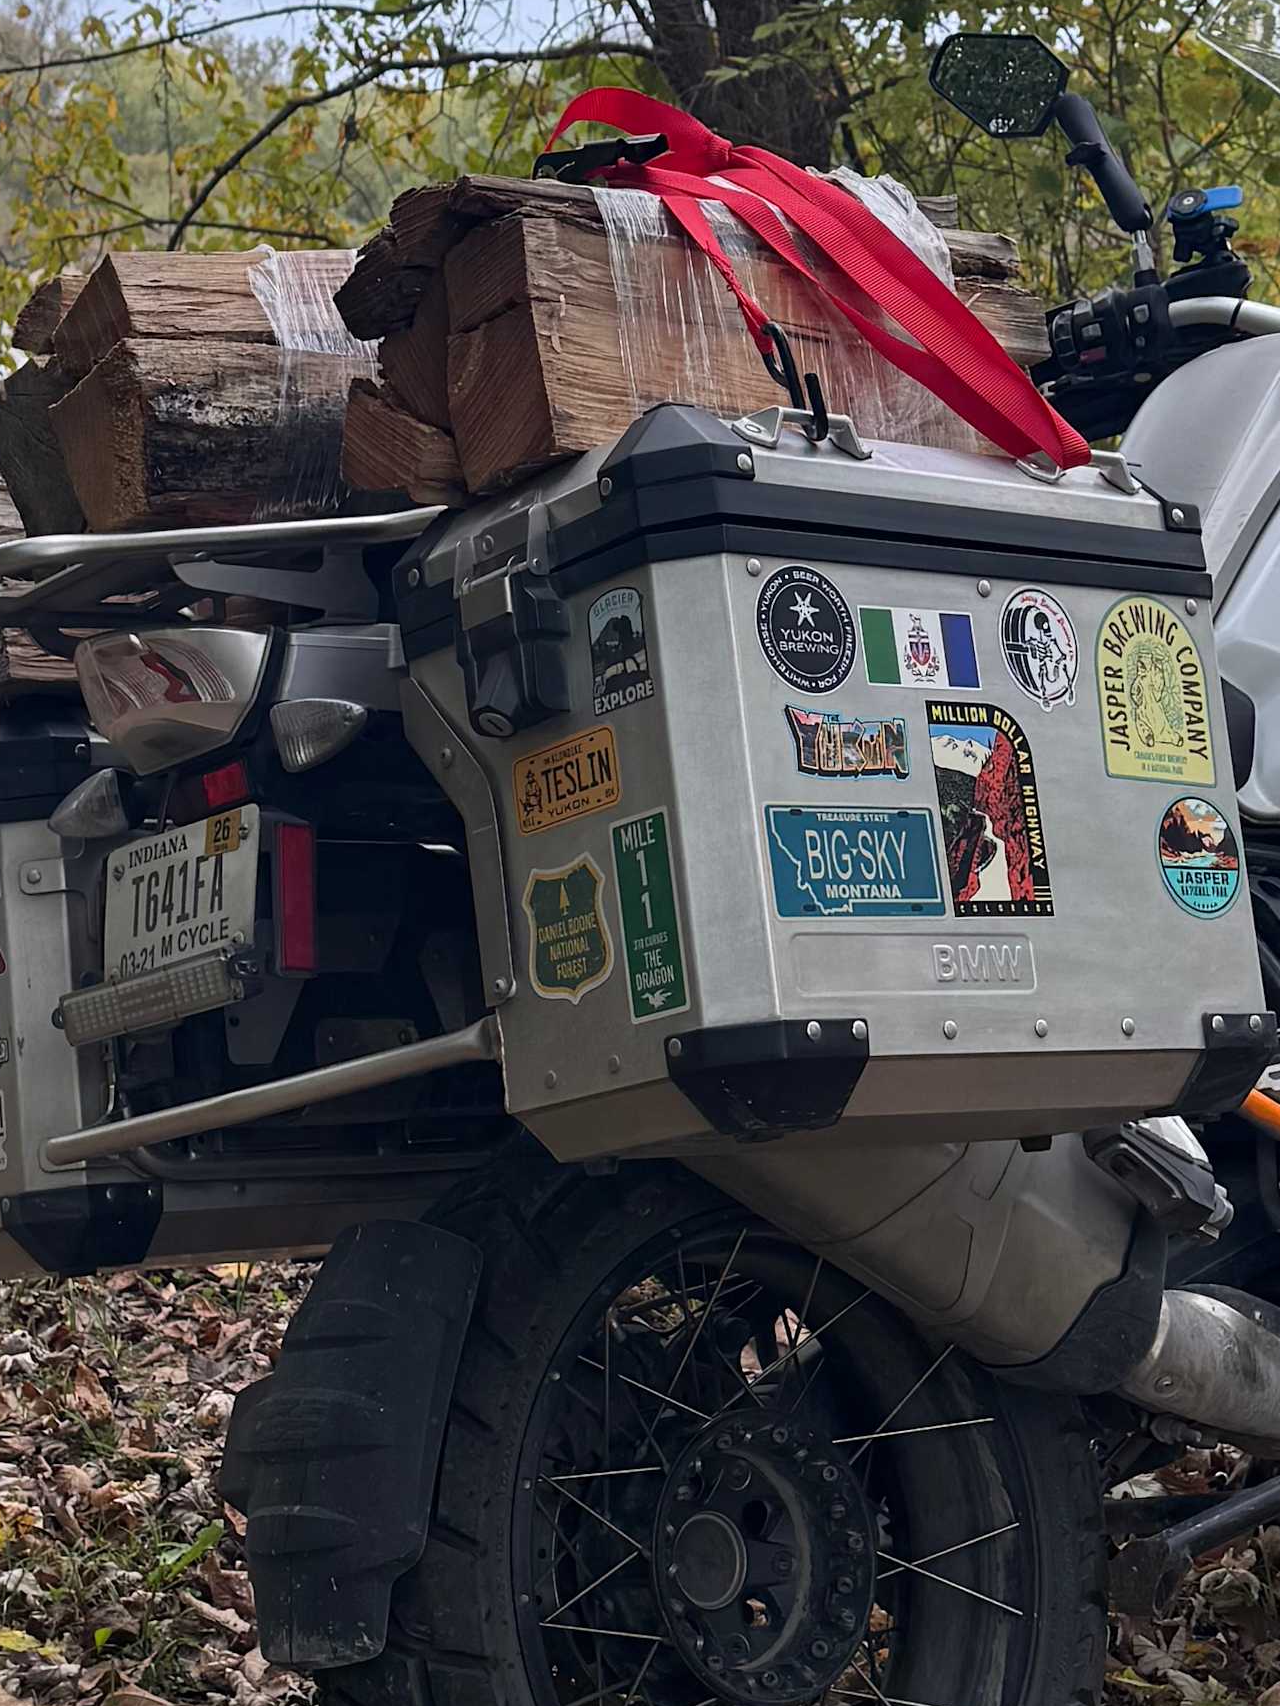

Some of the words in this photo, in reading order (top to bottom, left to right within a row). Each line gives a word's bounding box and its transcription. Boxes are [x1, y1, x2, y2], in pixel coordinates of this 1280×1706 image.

[761, 576, 783, 612] YUKON
[792, 570, 820, 585] BEER
[593, 592, 634, 618] GLACIER
[821, 579, 851, 624] WORTH
[779, 640, 840, 655] BREWING
[780, 627, 835, 644] YUKON
[1103, 603, 1179, 659] BREWING
[760, 621, 811, 689] WHITEHORSE
[593, 679, 654, 715] EXPLORE
[817, 673, 839, 689] FOR
[1103, 665, 1131, 752] JASPER
[1175, 645, 1209, 761] COMPANY
[784, 704, 911, 779] YUKON
[541, 746, 613, 804] TESLIN
[931, 704, 989, 724] MILLION
[992, 709, 1032, 775] DOLLAR
[1021, 784, 1046, 870] HIGHWAY
[547, 796, 590, 818] YUKON
[816, 812, 862, 822] TREASURE
[863, 813, 890, 823] STATE
[213, 817, 231, 843] 26
[620, 818, 656, 853] MILE
[128, 834, 188, 869] INDIANA
[636, 849, 649, 886] 1
[805, 829, 853, 881] BIG
[857, 829, 907, 880] SKY
[131, 851, 224, 938] T641FA
[825, 884, 902, 899] MONTANA
[1177, 870, 1229, 886] JASPER
[641, 891, 653, 929] 1
[960, 904, 1052, 914] COLORADO
[161, 934, 173, 958] M
[177, 917, 230, 953] CYCLE
[538, 920, 568, 944] DANIEL
[569, 911, 597, 937] BOONE
[549, 934, 591, 961] NATIONAL
[643, 948, 663, 969] THE
[932, 943, 1022, 983] BMW
[556, 956, 588, 981] FOREST
[635, 964, 675, 991] DRAGON
